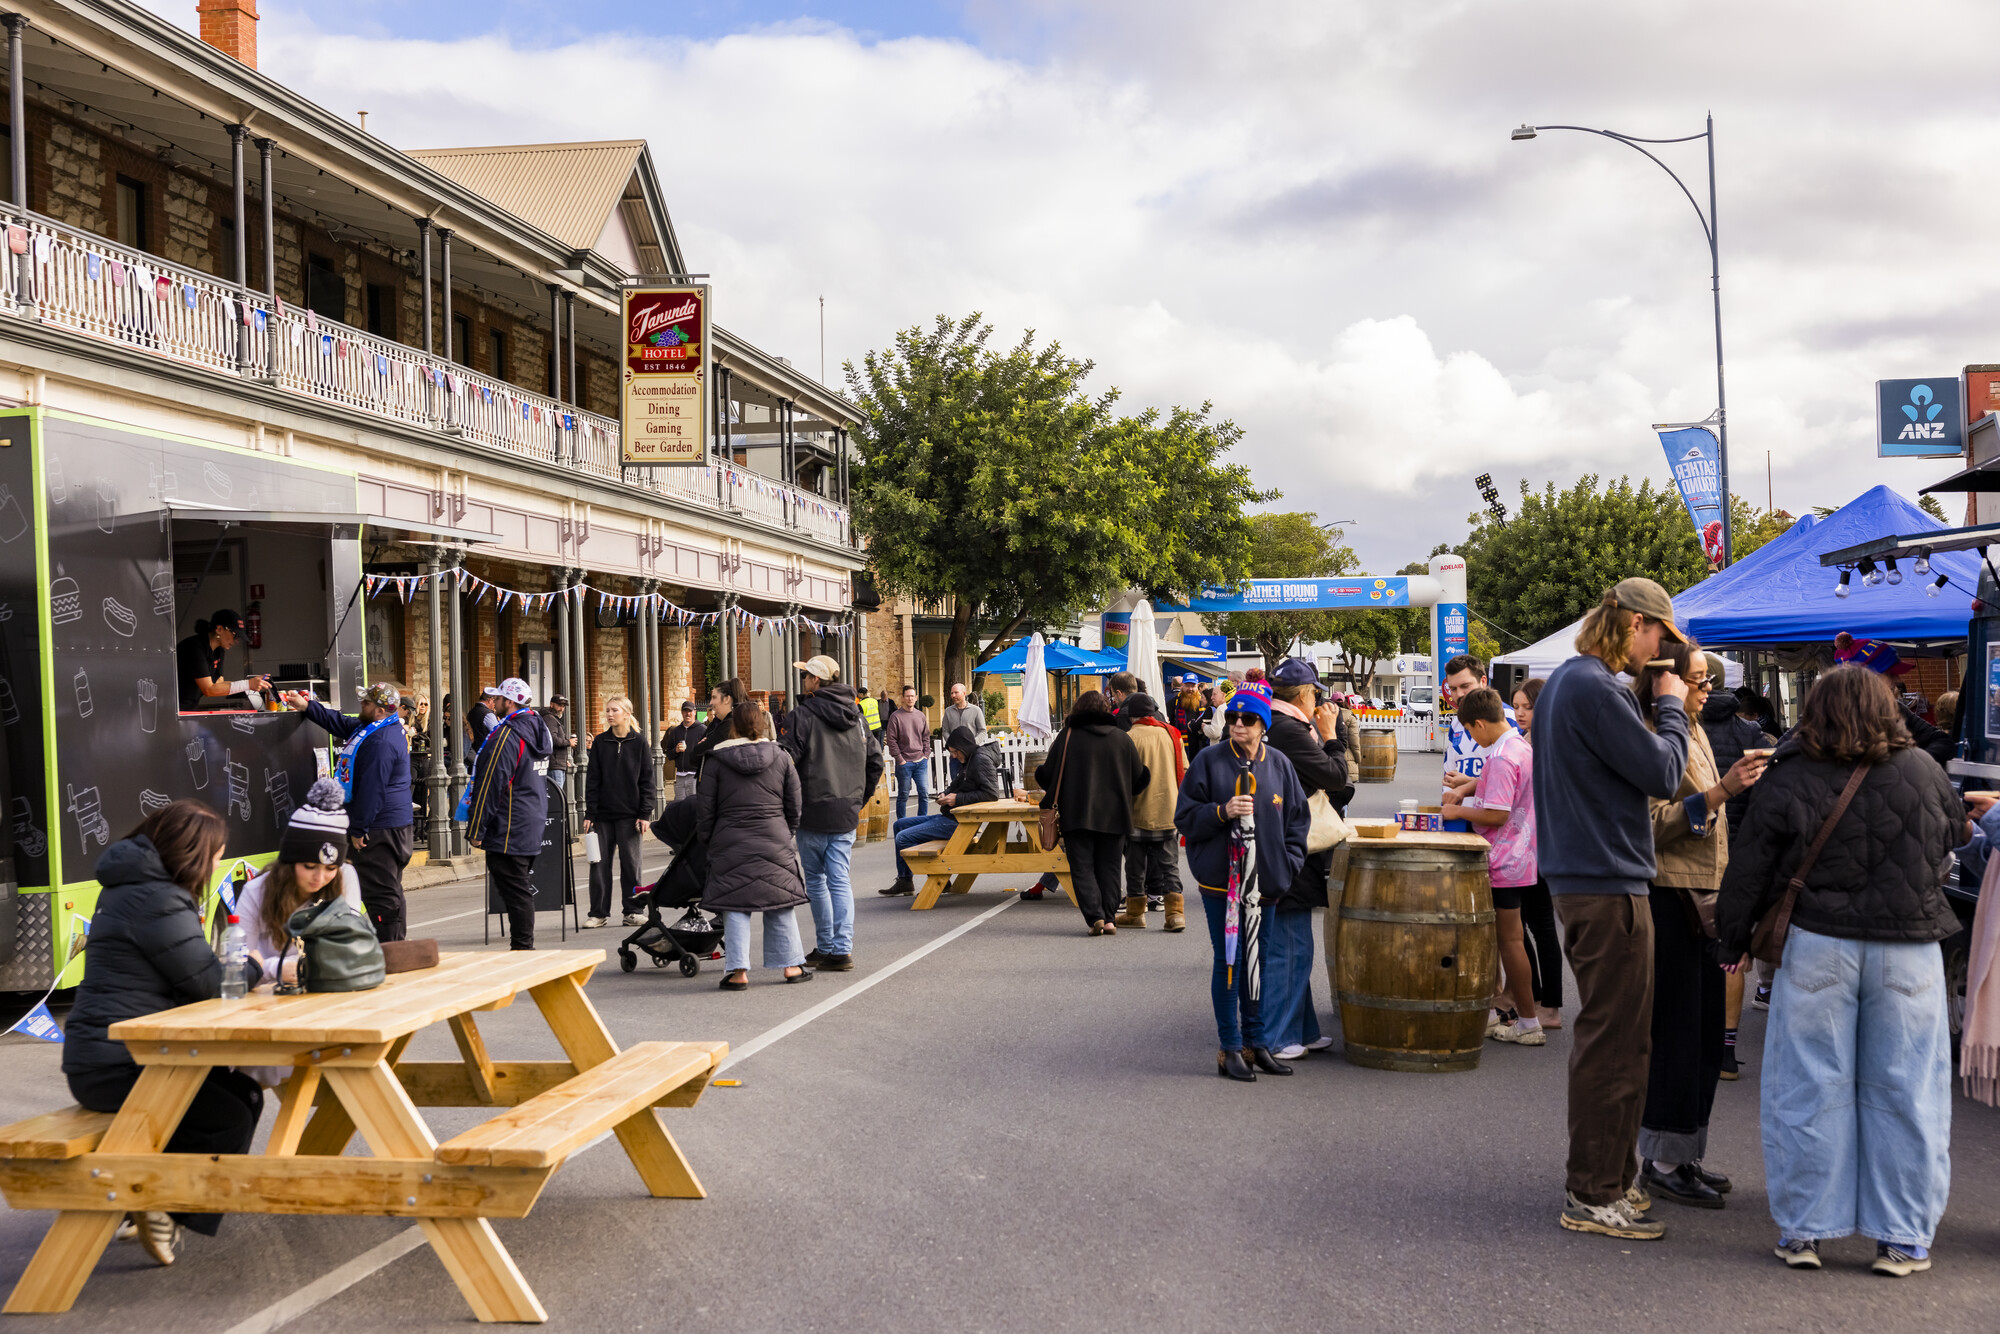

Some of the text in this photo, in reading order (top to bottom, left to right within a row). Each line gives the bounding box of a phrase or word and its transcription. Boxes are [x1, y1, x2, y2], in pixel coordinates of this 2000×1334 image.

[630, 299, 696, 343] Tanunda
[644, 349, 685, 359] HOTEL
[644, 363, 660, 371] EST
[632, 383, 697, 396] Accommodation
[648, 403, 680, 417] Dining
[646, 422, 682, 436] Gaming
[1898, 422, 1945, 440] ANZ
[634, 441, 693, 453] Beer Garden
[1440, 563, 1465, 571] ADELAIDE
[1283, 584, 1318, 598] ROUND
[1444, 616, 1465, 625] GATHER
[1445, 624, 1465, 634] ROUND
[1095, 666, 1121, 674] HAHN
